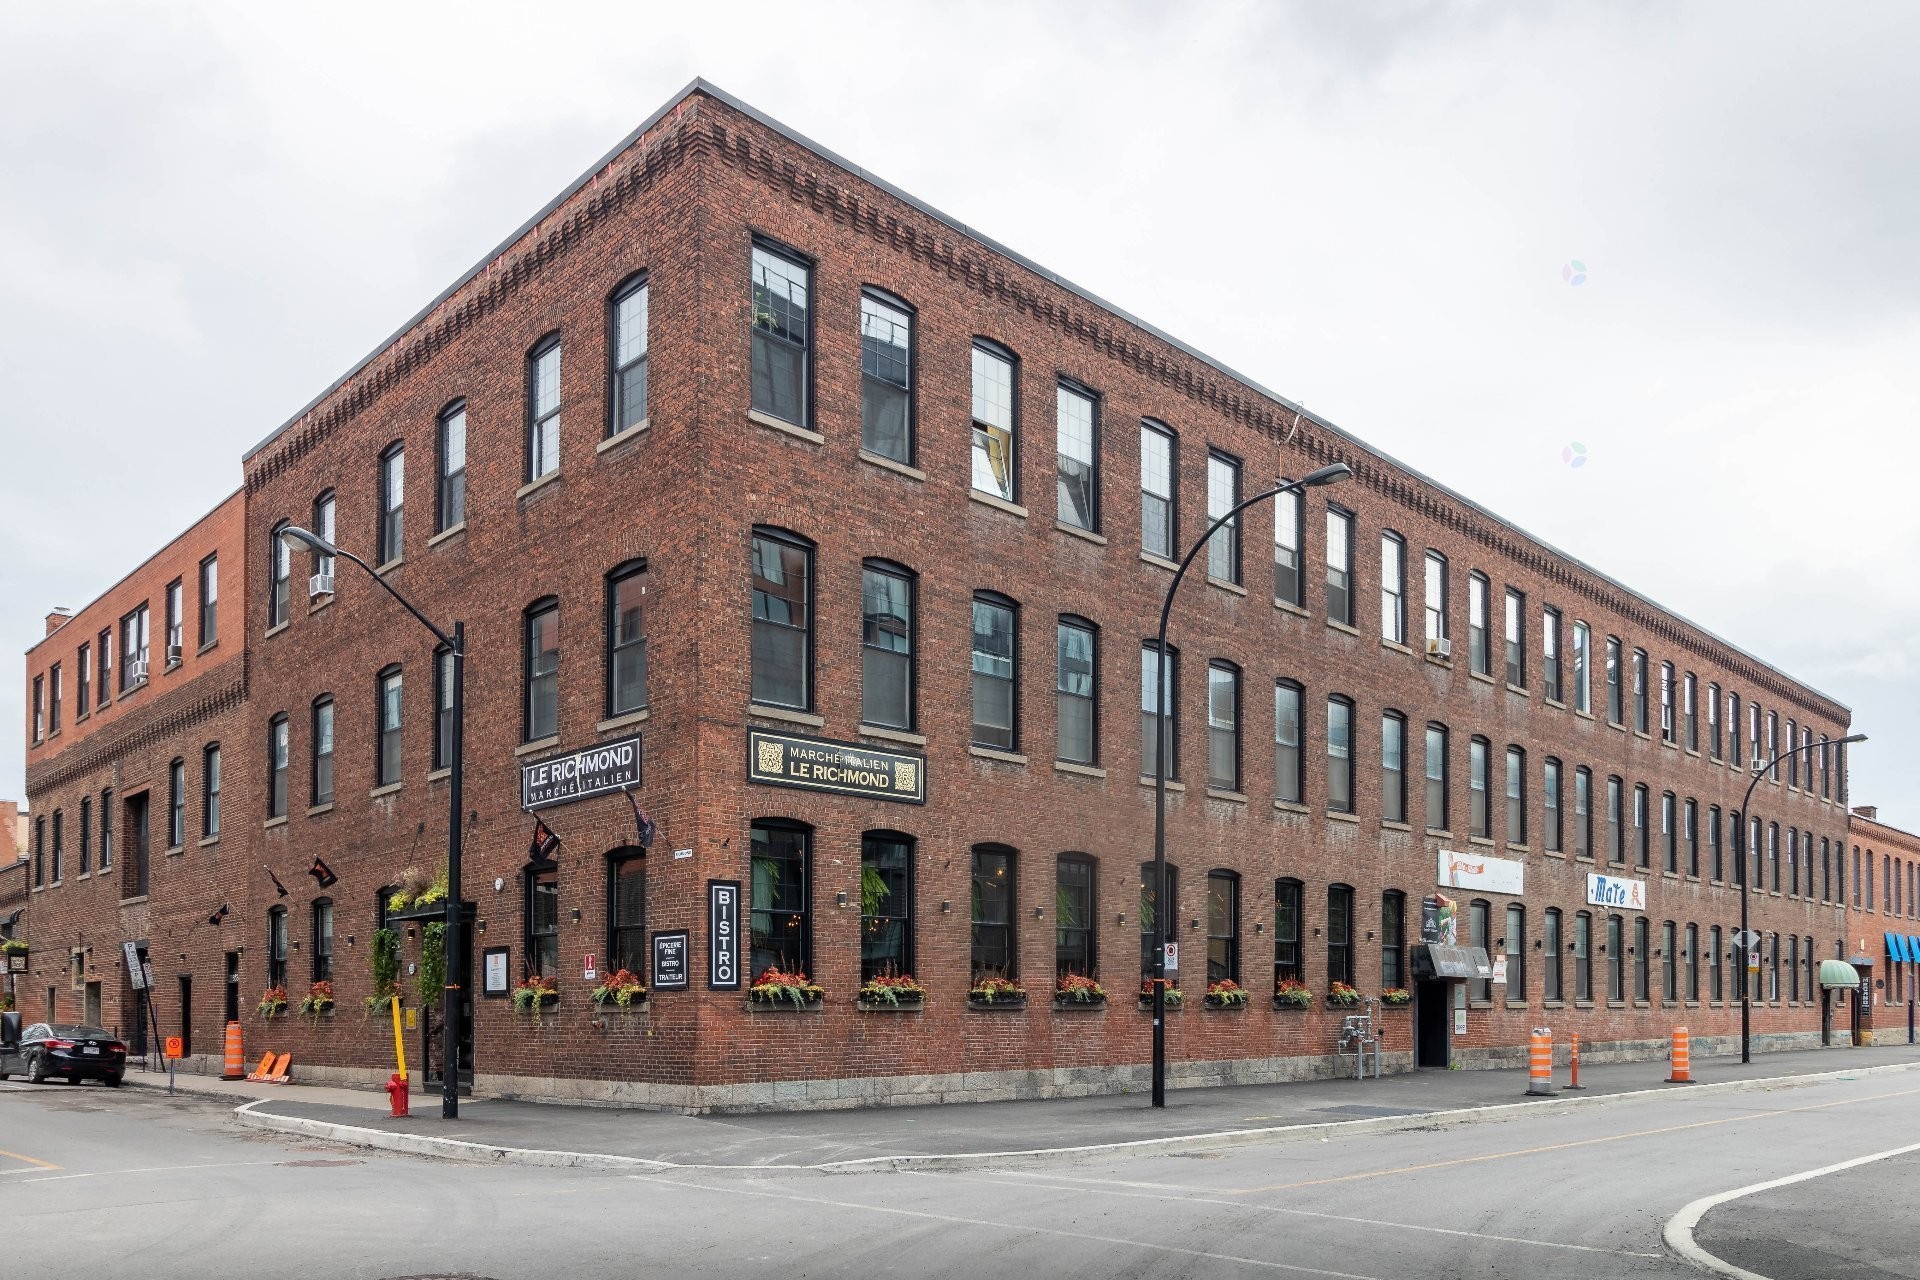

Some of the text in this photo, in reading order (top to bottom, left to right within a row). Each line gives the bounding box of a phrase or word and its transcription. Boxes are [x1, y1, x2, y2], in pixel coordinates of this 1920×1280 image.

[530, 745, 633, 787] LE RICHMOND
[790, 747, 889, 771] MARCHÉ ITALIEN
[530, 770, 632, 801] MARCHÉ ITALIEN
[790, 761, 890, 788] LE RICHMOND
[718, 890, 731, 980] BISTRO
[661, 960, 680, 968] BISTRO
